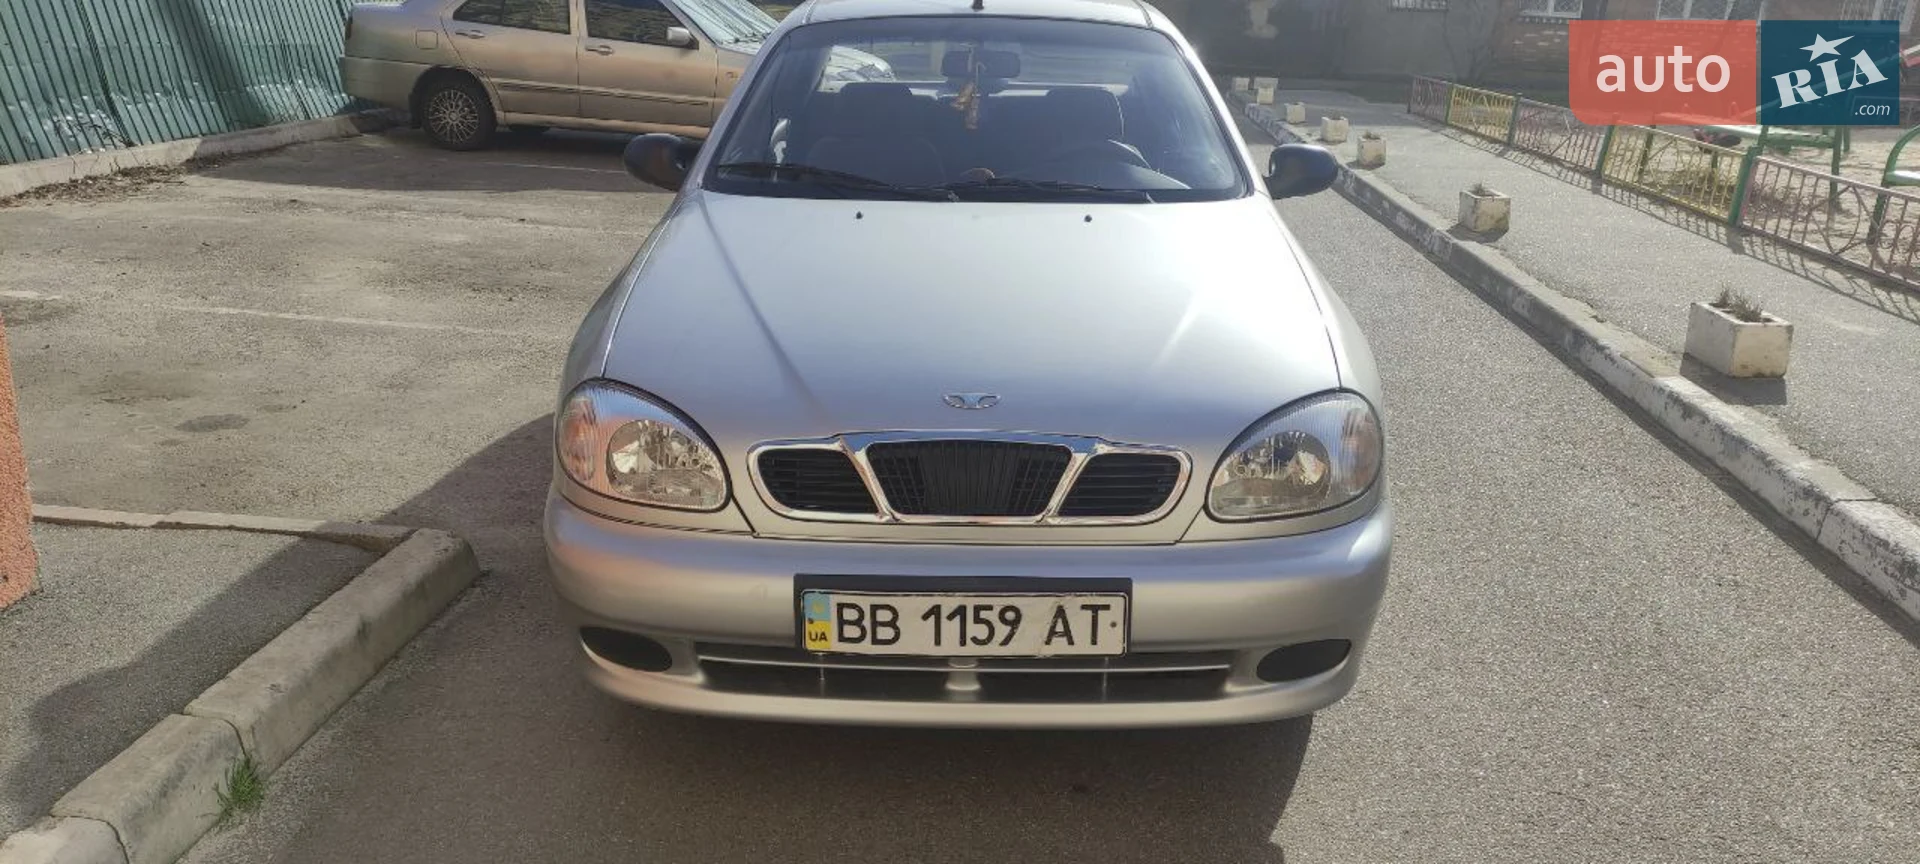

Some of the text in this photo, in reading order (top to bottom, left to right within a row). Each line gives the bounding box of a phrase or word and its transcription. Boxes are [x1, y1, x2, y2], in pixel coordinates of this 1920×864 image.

[808, 631, 828, 643] UA
[836, 602, 1110, 648] BB 1159 AT
